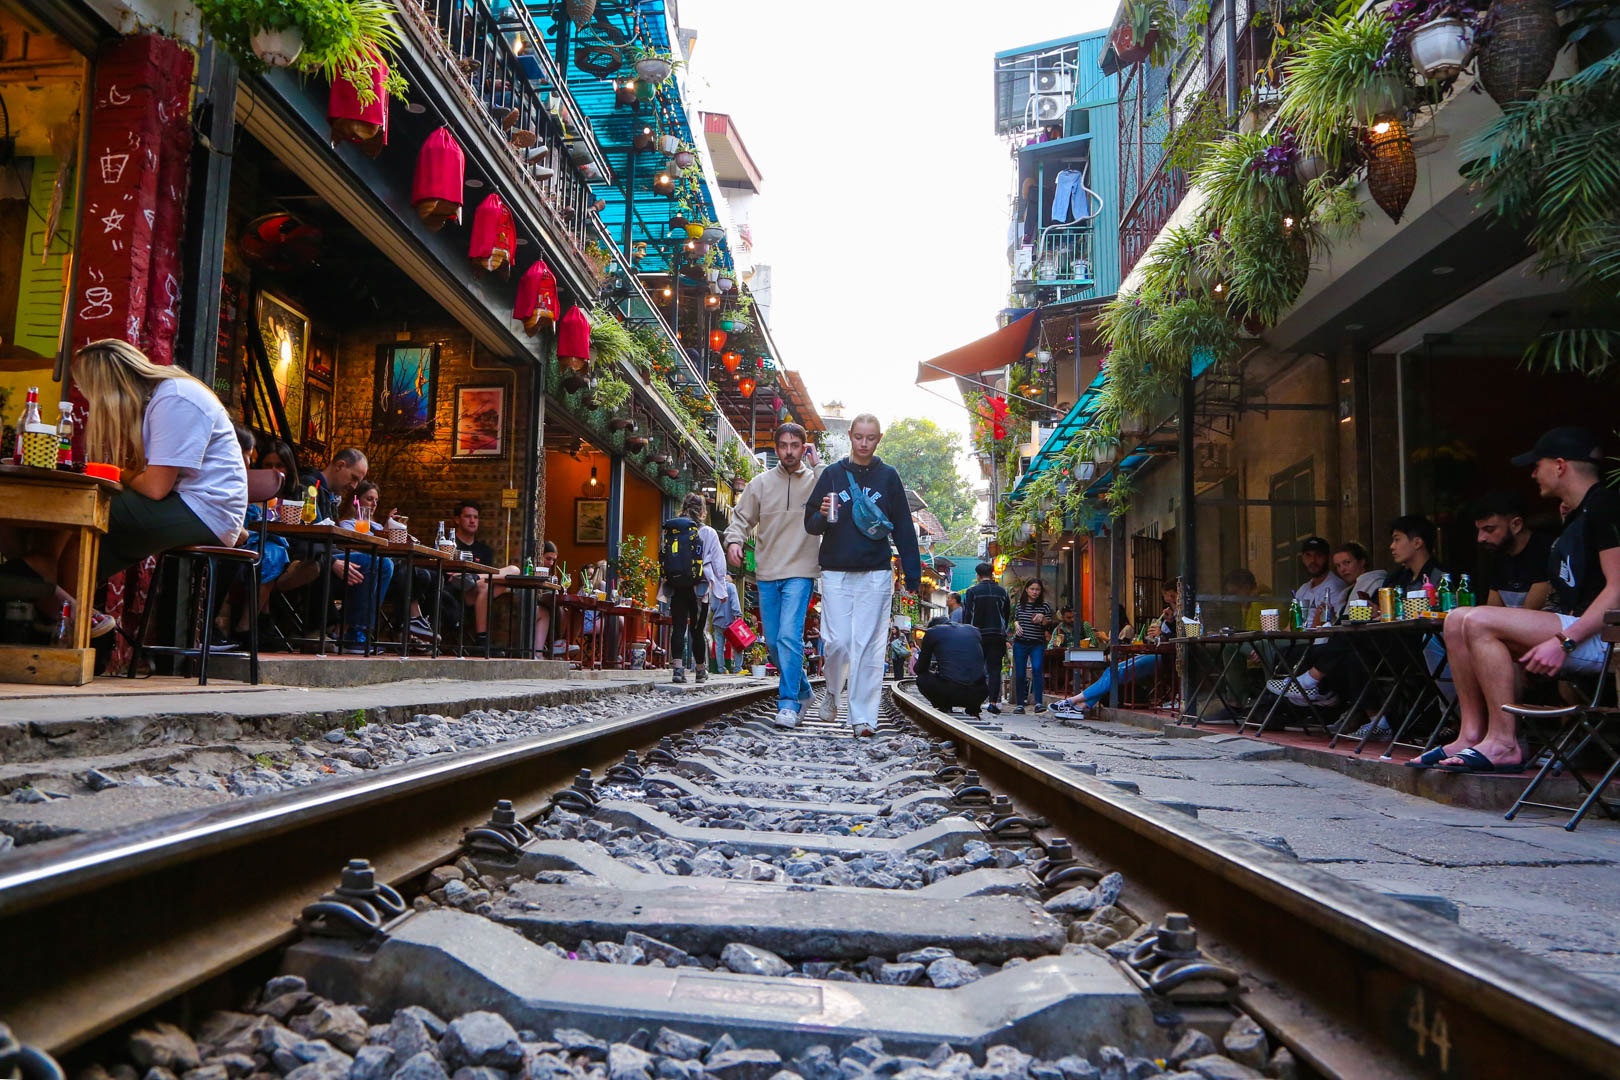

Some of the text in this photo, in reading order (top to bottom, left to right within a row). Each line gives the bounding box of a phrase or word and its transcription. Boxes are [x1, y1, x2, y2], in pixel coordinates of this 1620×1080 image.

[214, 377, 231, 393] ffee
[838, 486, 882, 504] NKE
[1407, 986, 1453, 1072] 44
